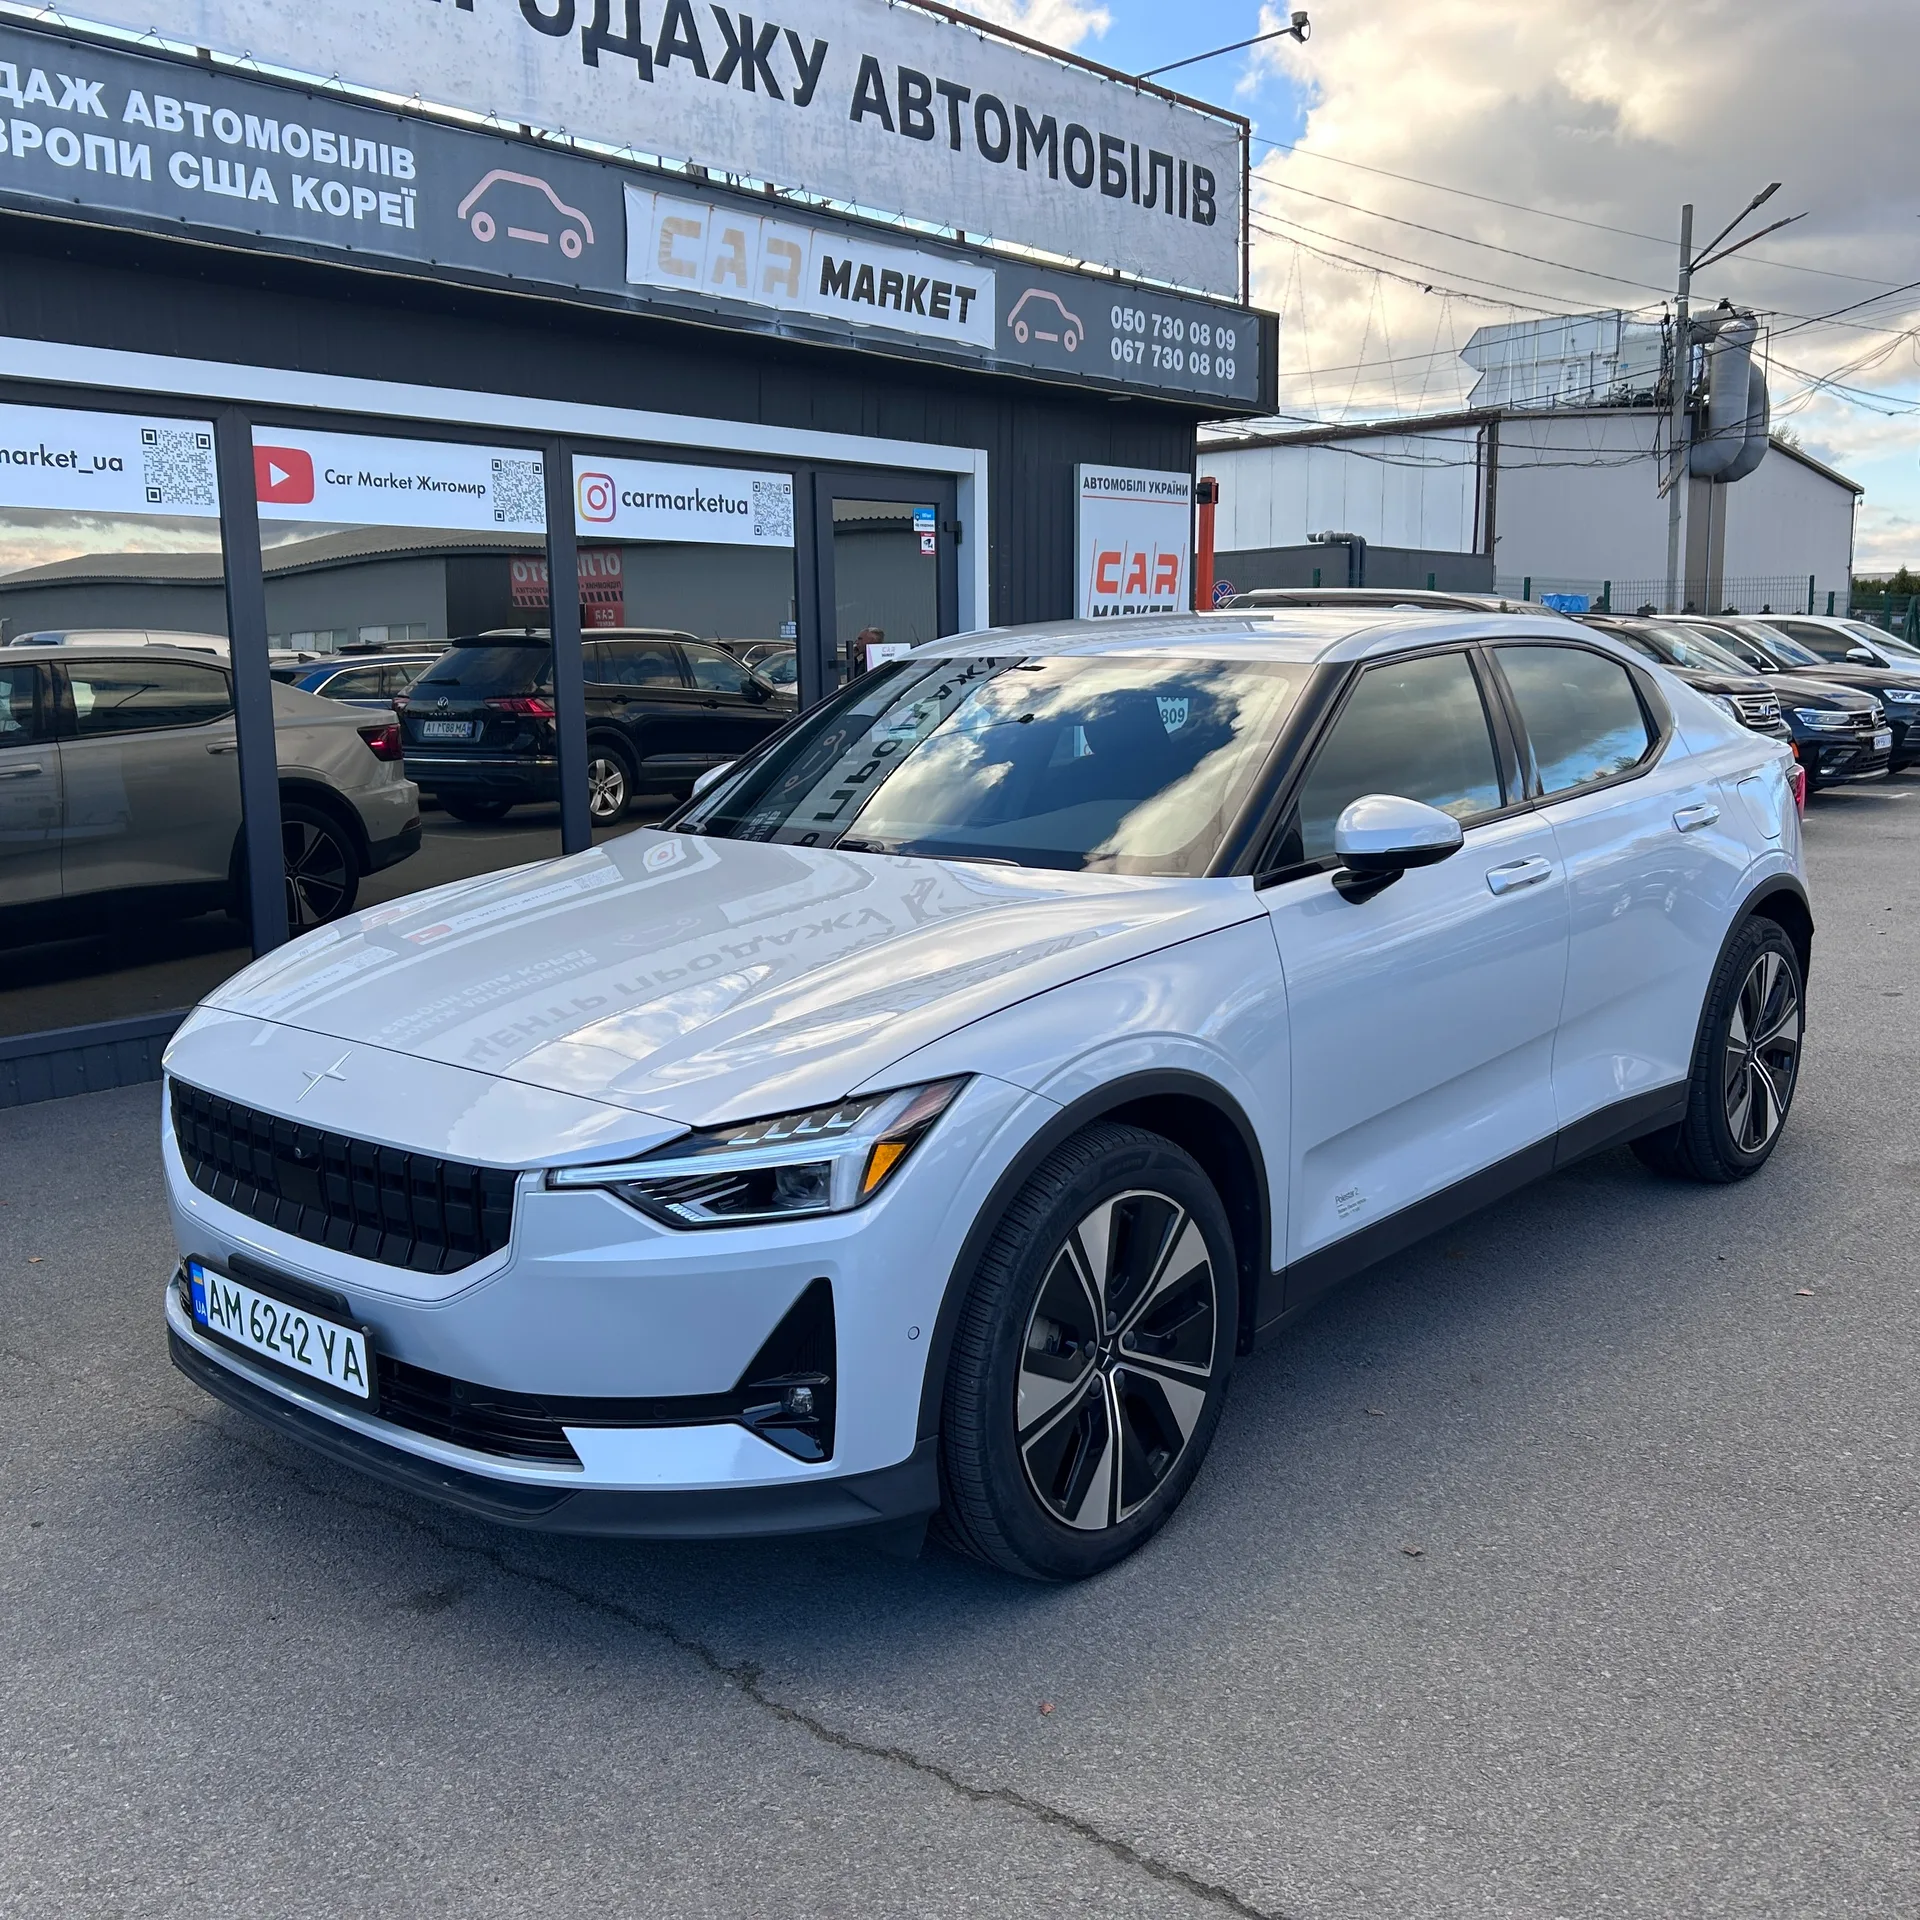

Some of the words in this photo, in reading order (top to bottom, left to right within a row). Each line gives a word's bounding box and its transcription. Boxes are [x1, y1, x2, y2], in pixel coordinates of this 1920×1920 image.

[122, 90, 417, 180] АВТОМОБІЛІВ
[849, 53, 1217, 226] АВТОМОБІЛІВ
[168, 151, 279, 205] США
[291, 173, 417, 229] КОРЕЇ
[658, 215, 802, 299] CAR
[819, 255, 976, 324] MARKET
[1110, 305, 1146, 334] 050
[1151, 313, 1184, 341] 730
[1189, 321, 1211, 346] 08
[1215, 327, 1236, 351] 09
[1110, 337, 1145, 365] 067
[1151, 344, 1184, 371] 730
[1189, 351, 1211, 376] 08
[1215, 356, 1236, 380] 09
[324, 468, 353, 486] Car
[358, 471, 413, 490] Market
[417, 475, 486, 499] Житомир
[621, 487, 748, 515] carmarketua
[1083, 476, 1146, 493] АВТОМОБІЛІ
[1149, 480, 1189, 497] УКРАЇНИ
[1096, 551, 1179, 595] CAR
[195, 1299, 207, 1317] UA
[209, 1279, 244, 1336] AM
[250, 1299, 312, 1366] 6242
[317, 1324, 365, 1388] YA
